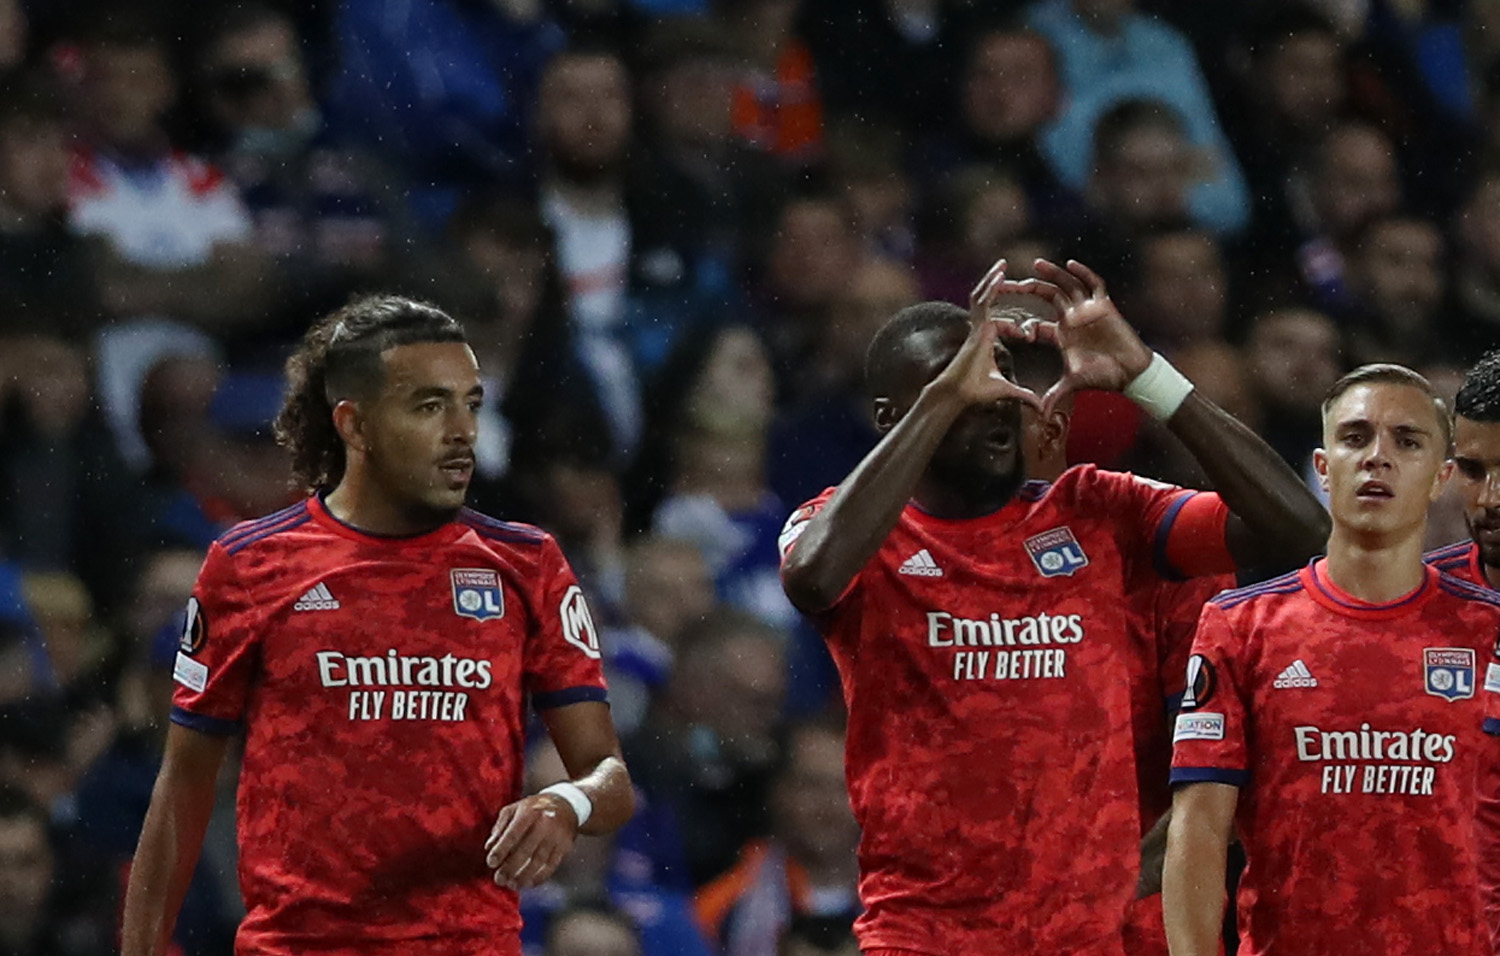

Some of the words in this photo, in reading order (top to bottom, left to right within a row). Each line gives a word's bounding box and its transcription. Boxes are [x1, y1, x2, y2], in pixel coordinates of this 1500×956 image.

[899, 566, 943, 577] adidas
[294, 599, 340, 611] adidas
[926, 611, 1084, 647] Emirates
[316, 649, 492, 689] Emirates
[954, 650, 989, 680] FLY
[995, 649, 1065, 680] BETTER
[1273, 676, 1317, 689] adidas
[1430, 669, 1470, 692] OL
[349, 691, 385, 721] FLY
[391, 691, 468, 721] BETTER
[1294, 722, 1456, 762] Emirates
[1321, 765, 1356, 794] FLY
[1362, 765, 1435, 795] BETTER
